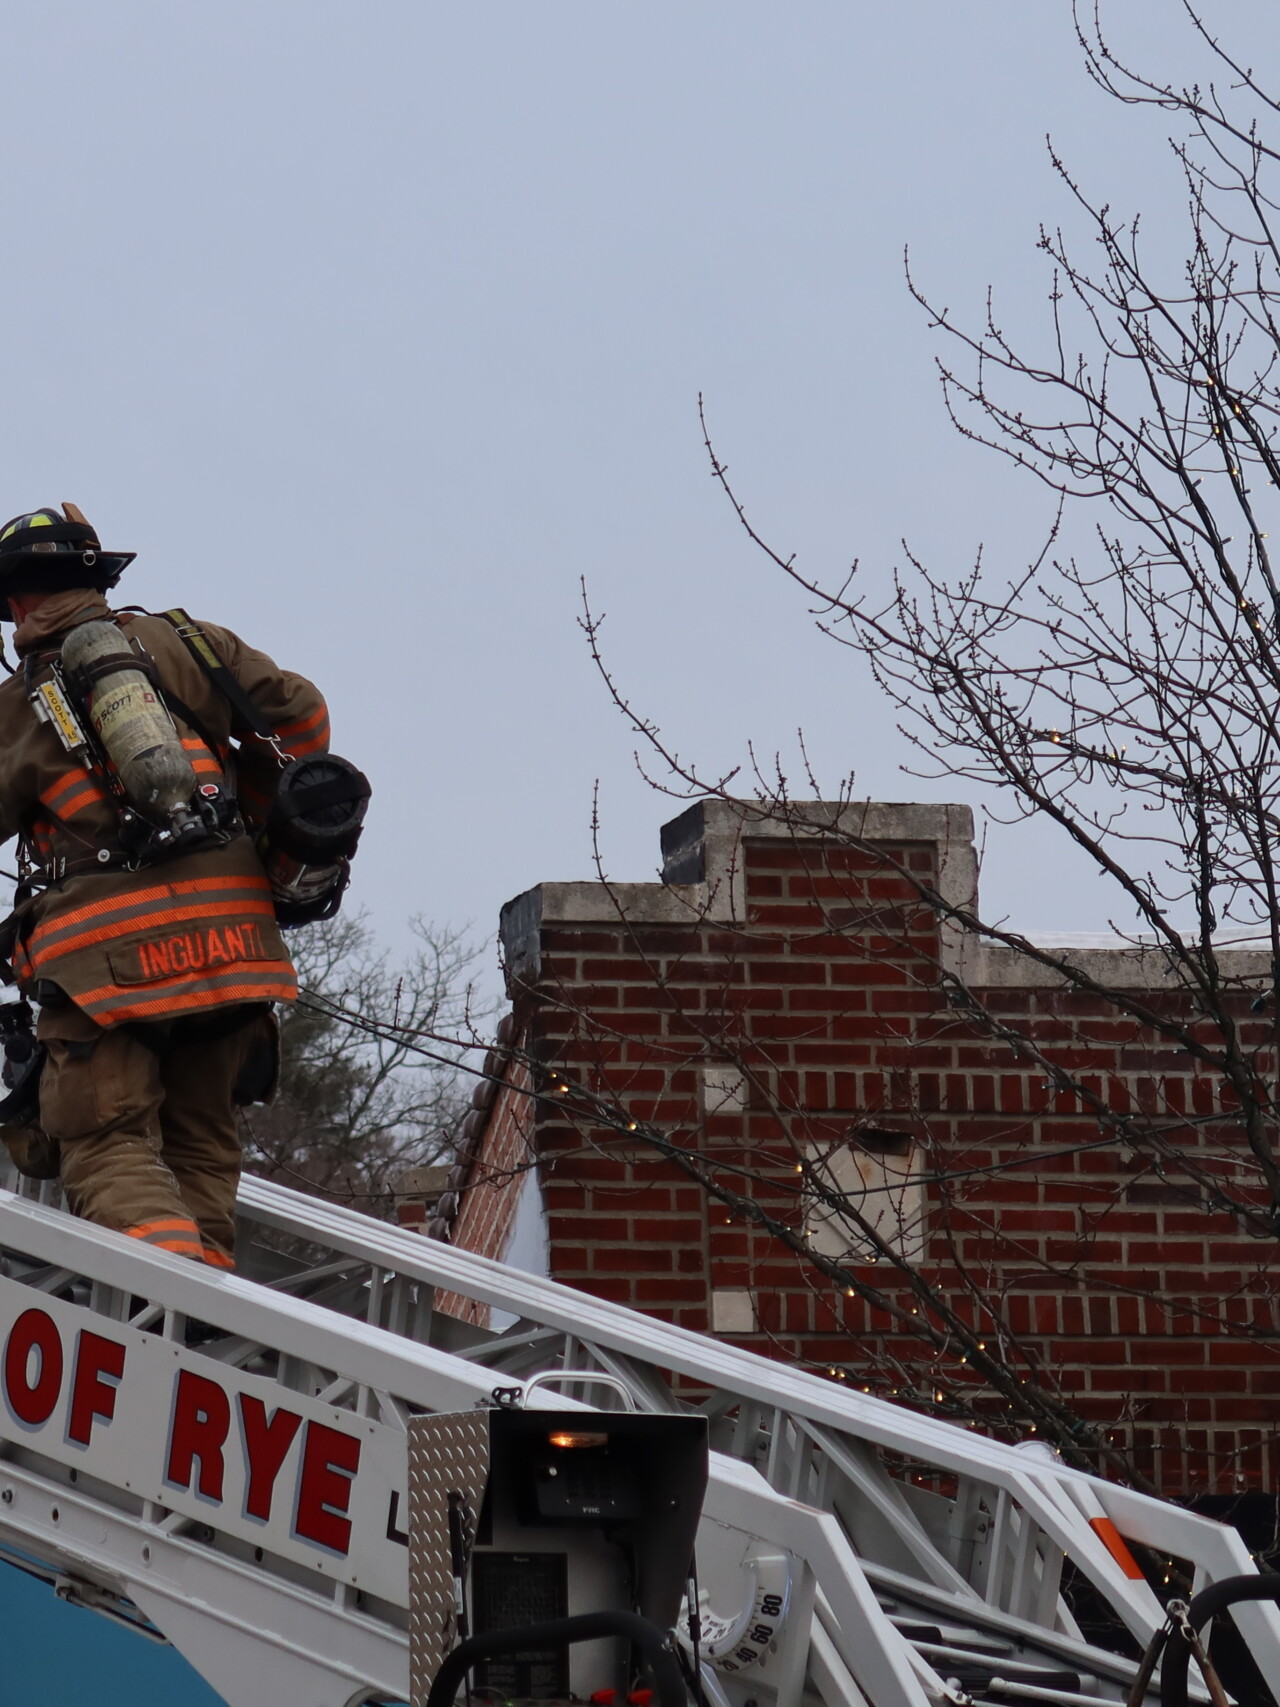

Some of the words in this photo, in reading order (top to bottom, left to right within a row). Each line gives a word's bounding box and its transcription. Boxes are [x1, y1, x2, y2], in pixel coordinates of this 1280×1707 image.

[47, 690, 68, 726] SCOTT
[101, 694, 132, 721] SCOTT
[2, 1308, 126, 1447] OF
[165, 1368, 361, 1556] RYE
[761, 1594, 783, 1617] 80
[750, 1624, 773, 1645] 60
[736, 1647, 758, 1663] 40
